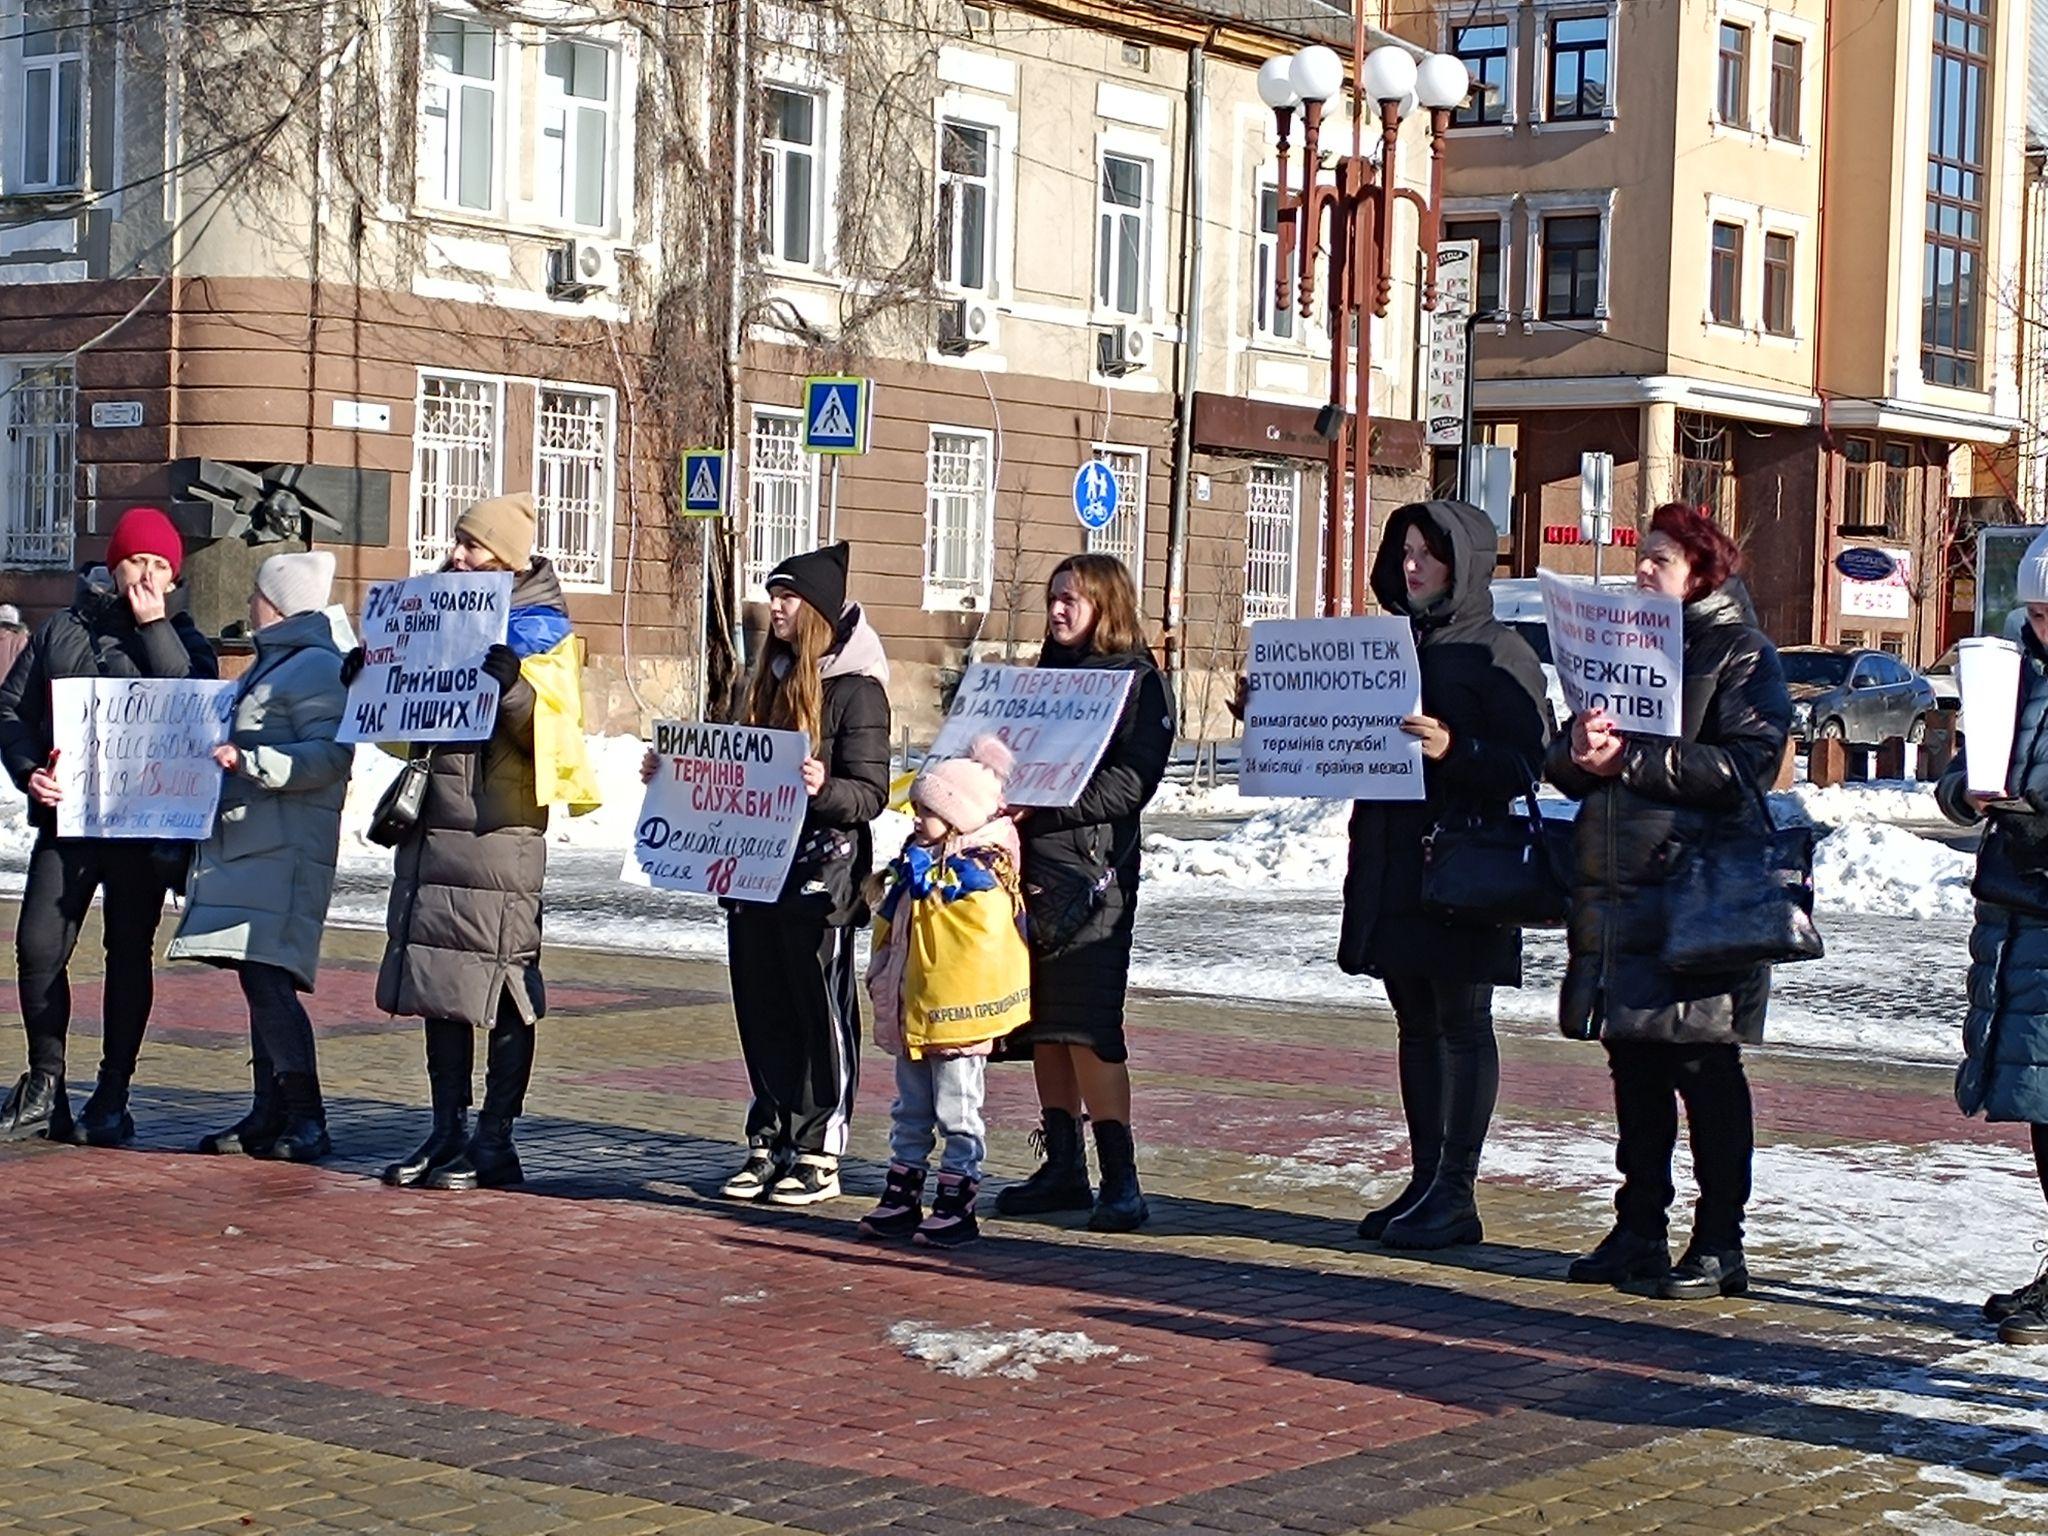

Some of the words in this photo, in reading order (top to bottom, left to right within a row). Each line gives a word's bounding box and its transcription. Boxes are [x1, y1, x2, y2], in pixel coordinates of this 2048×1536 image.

[1576, 602, 1670, 630] ПЕРШИМИ
[1255, 641, 1354, 663] ВІЙСЬКОВІ
[1361, 641, 1400, 661] ТЕЖ
[1585, 629, 1595, 644] В
[1602, 629, 1665, 650] СТРІЙ!
[973, 668, 1001, 693] ЗА
[1011, 671, 1123, 698] ПЕРЕМОГУ
[1250, 670, 1406, 692] ВТОМЛЮЮТЬСЯ!
[356, 702, 387, 734] ЧАС
[951, 695, 1114, 721] ВІДПОВІДАЛЬНІ
[1332, 713, 1401, 731] розумних
[656, 725, 774, 763] ВИМАГАЄМО
[1263, 736, 1324, 754] термінів
[673, 757, 745, 788] ТЕРМІНІВ
[691, 784, 798, 823] СЛУЖБИ!!!
[637, 816, 787, 860] Демобілізація
[705, 856, 738, 896] 18
